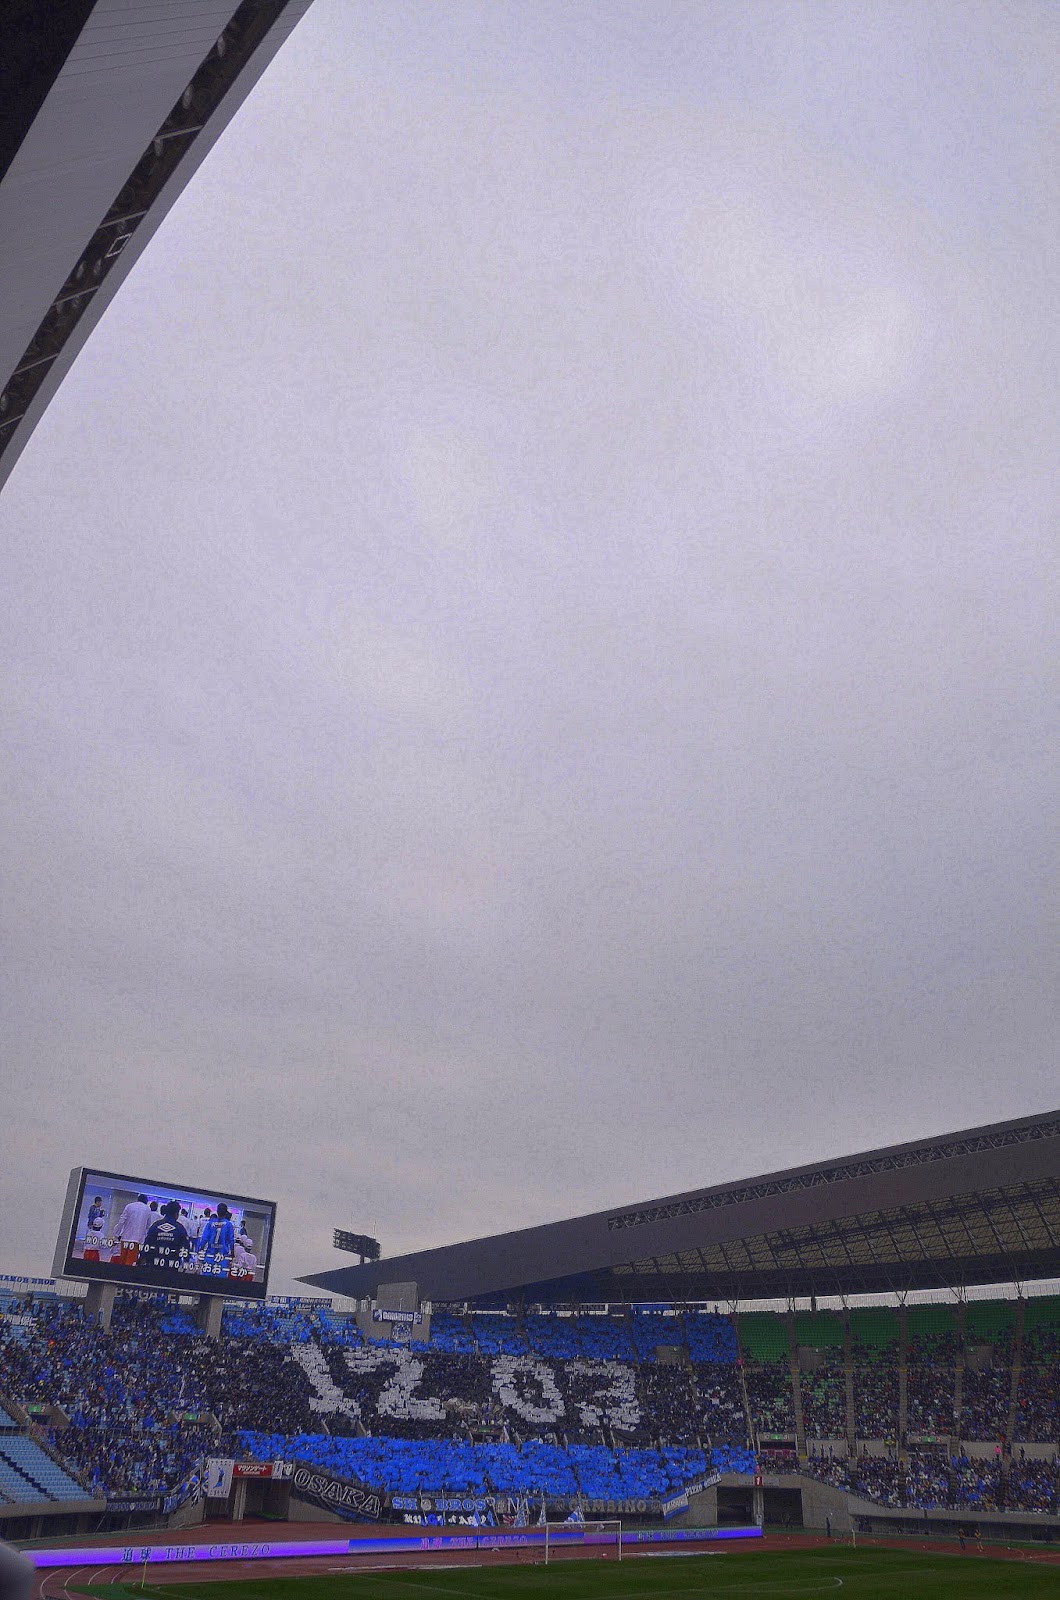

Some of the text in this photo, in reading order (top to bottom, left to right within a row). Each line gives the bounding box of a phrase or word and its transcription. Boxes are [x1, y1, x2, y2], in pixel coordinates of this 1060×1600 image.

[293, 1467, 381, 1519] OSAKA
[164, 1546, 197, 1559] THE
[209, 1543, 271, 1558] CEREZO
